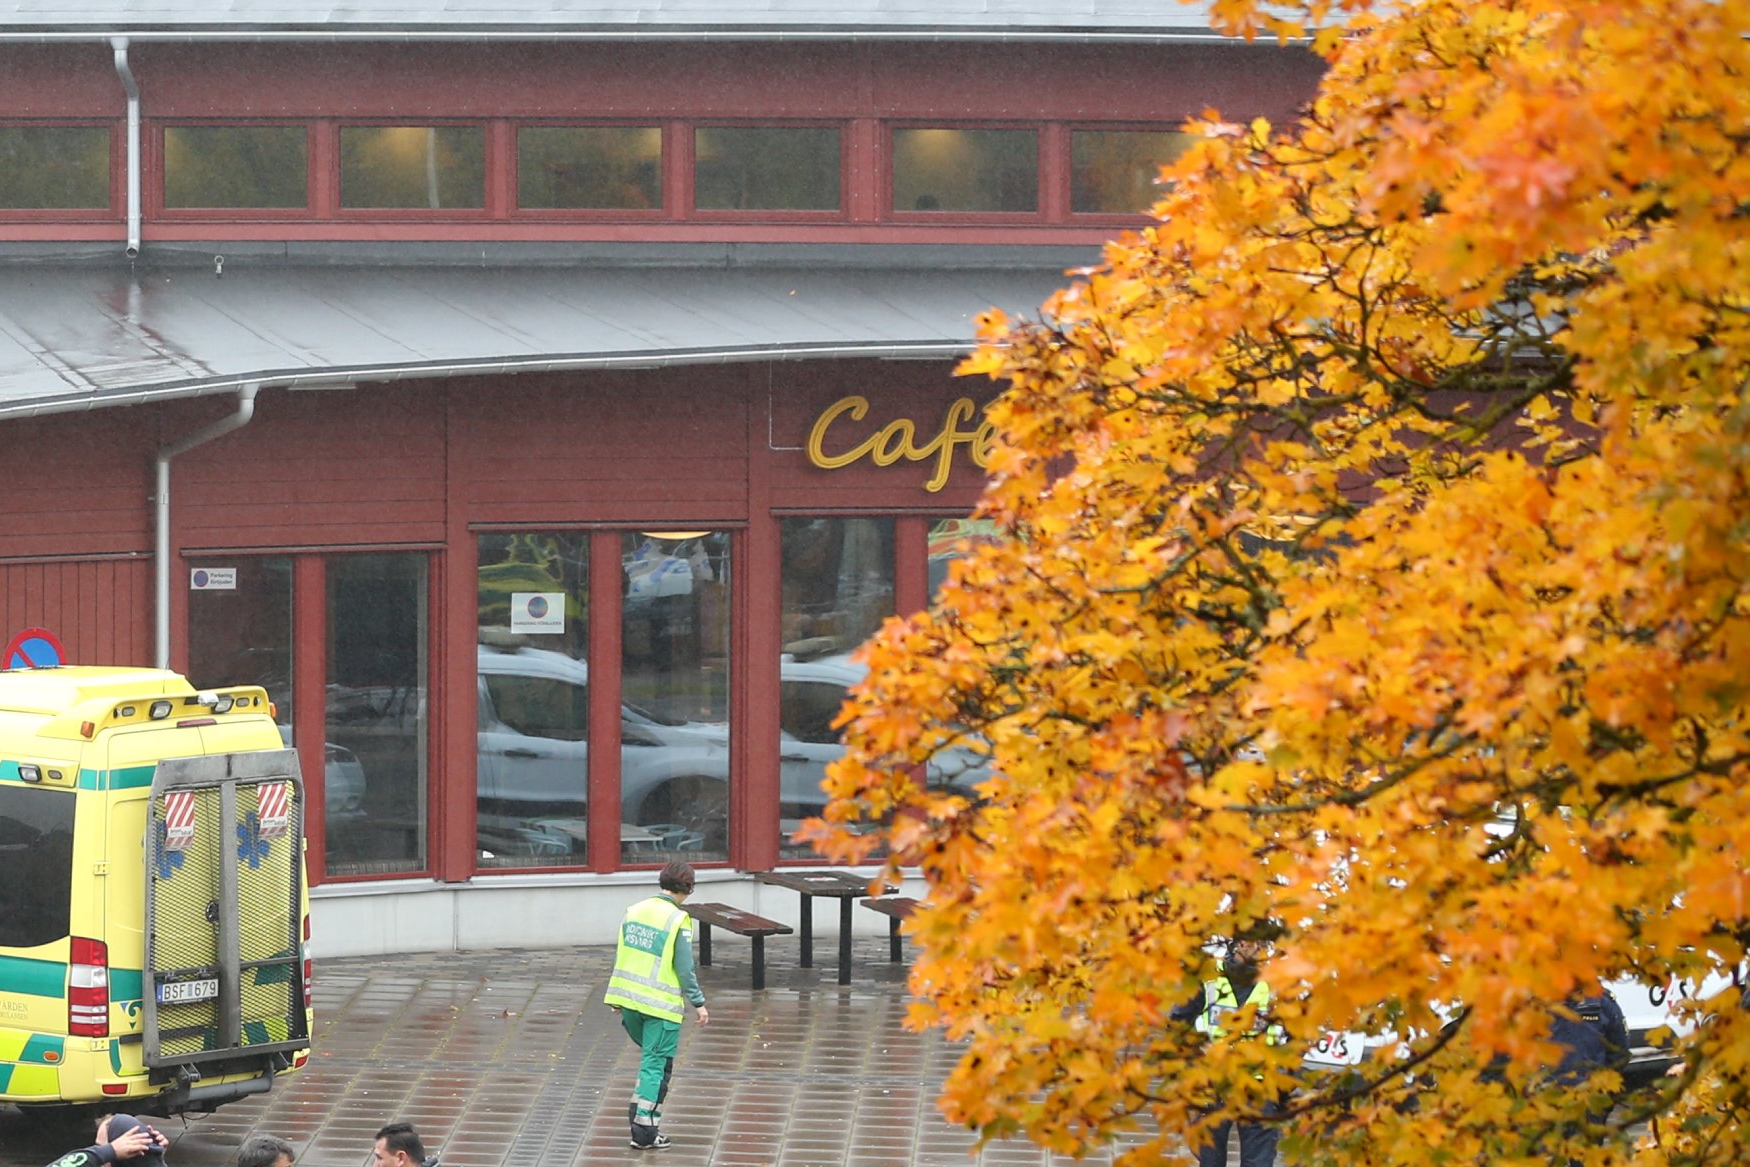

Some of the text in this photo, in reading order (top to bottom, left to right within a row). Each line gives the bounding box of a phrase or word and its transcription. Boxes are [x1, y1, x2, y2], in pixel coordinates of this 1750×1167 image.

[808, 395, 999, 493] Café
[164, 981, 217, 1000] BSF 679
